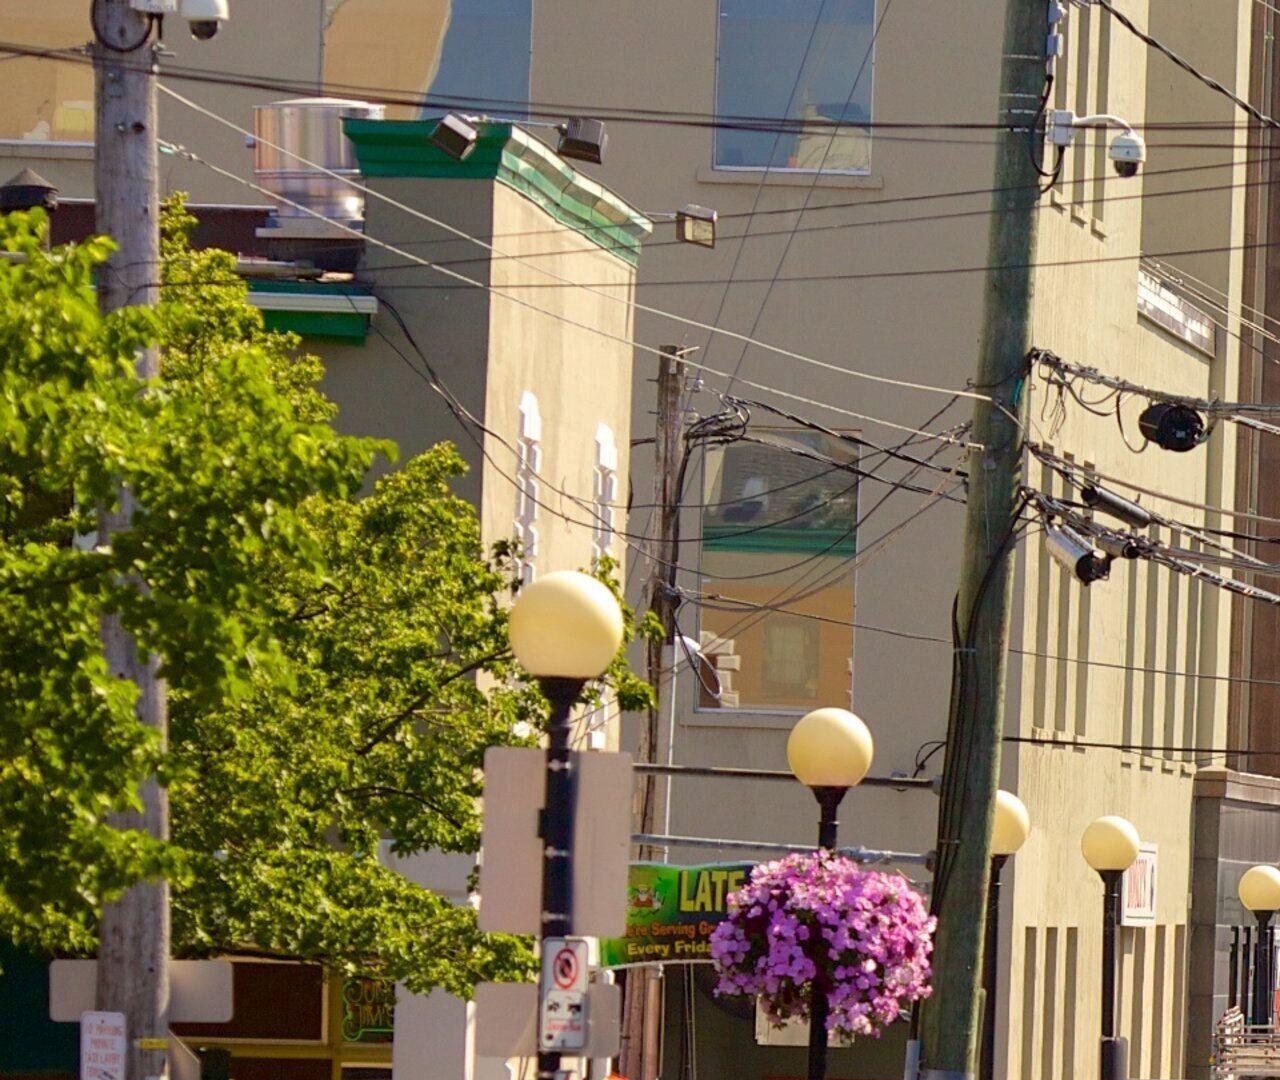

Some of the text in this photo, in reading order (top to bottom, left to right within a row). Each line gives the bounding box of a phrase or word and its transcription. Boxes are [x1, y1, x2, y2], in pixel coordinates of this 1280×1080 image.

[651, 921, 695, 938] Serving
[627, 940, 713, 957] Every Frida
